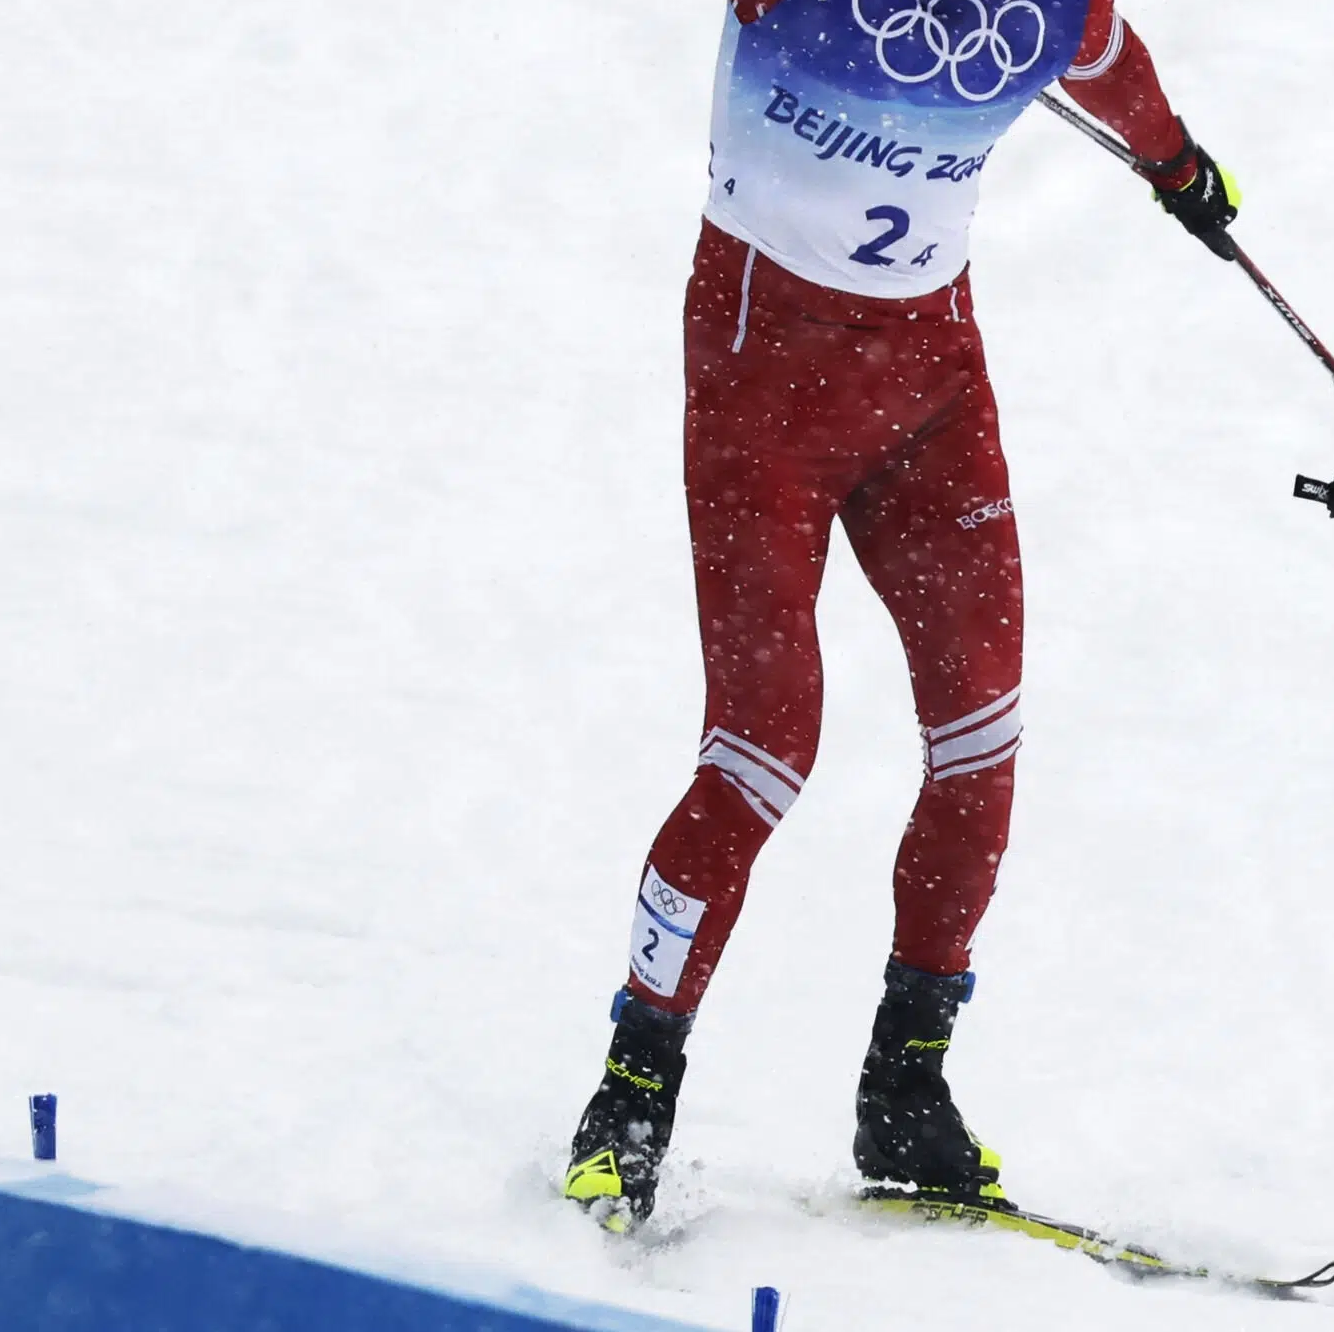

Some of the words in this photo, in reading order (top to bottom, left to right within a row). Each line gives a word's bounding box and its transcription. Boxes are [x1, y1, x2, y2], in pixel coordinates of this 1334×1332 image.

[763, 85, 922, 178] BEIJING
[724, 177, 736, 196] 4
[848, 205, 910, 266] 2
[910, 243, 939, 267] 4
[641, 927, 659, 963] 2
